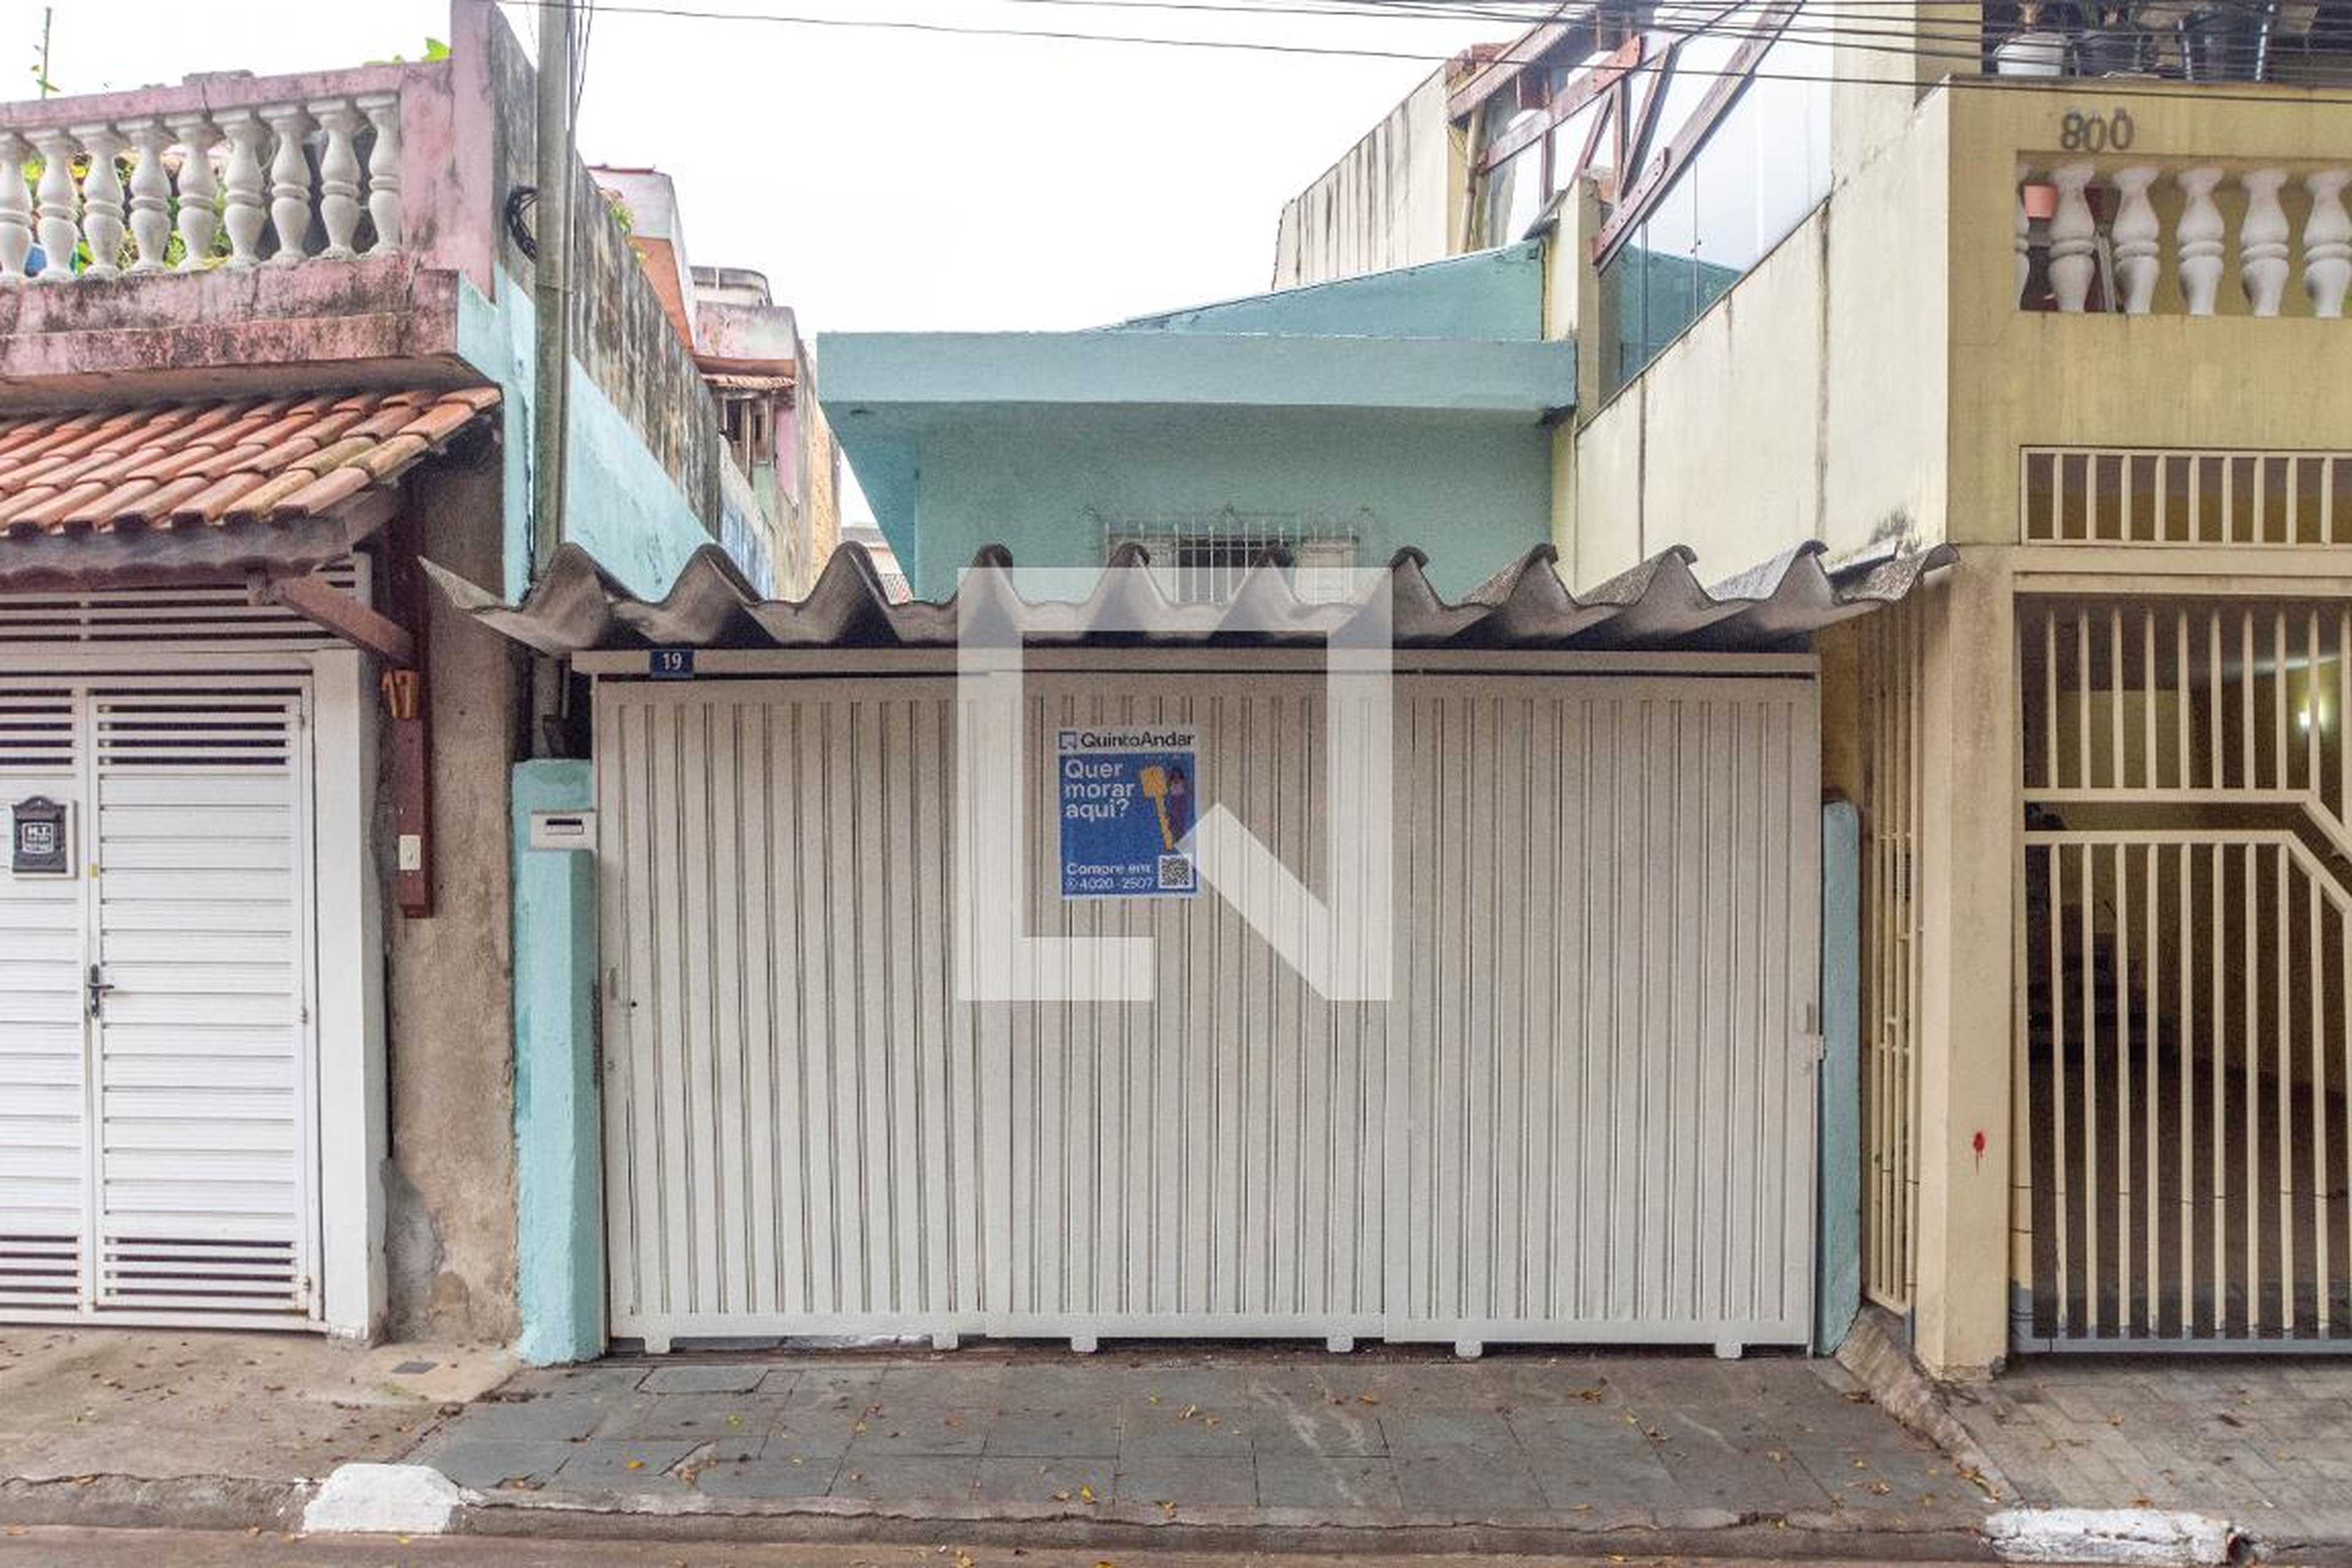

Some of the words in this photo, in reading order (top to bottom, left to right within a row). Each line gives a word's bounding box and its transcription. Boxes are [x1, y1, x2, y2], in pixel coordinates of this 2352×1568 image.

[2060, 108, 2135, 153] 800
[662, 652, 682, 671] 19
[1081, 732, 1194, 748] QuintoAndar
[1065, 759, 1123, 779] Quer
[1065, 783, 1135, 799] morar
[1065, 798, 1130, 823] aqui?
